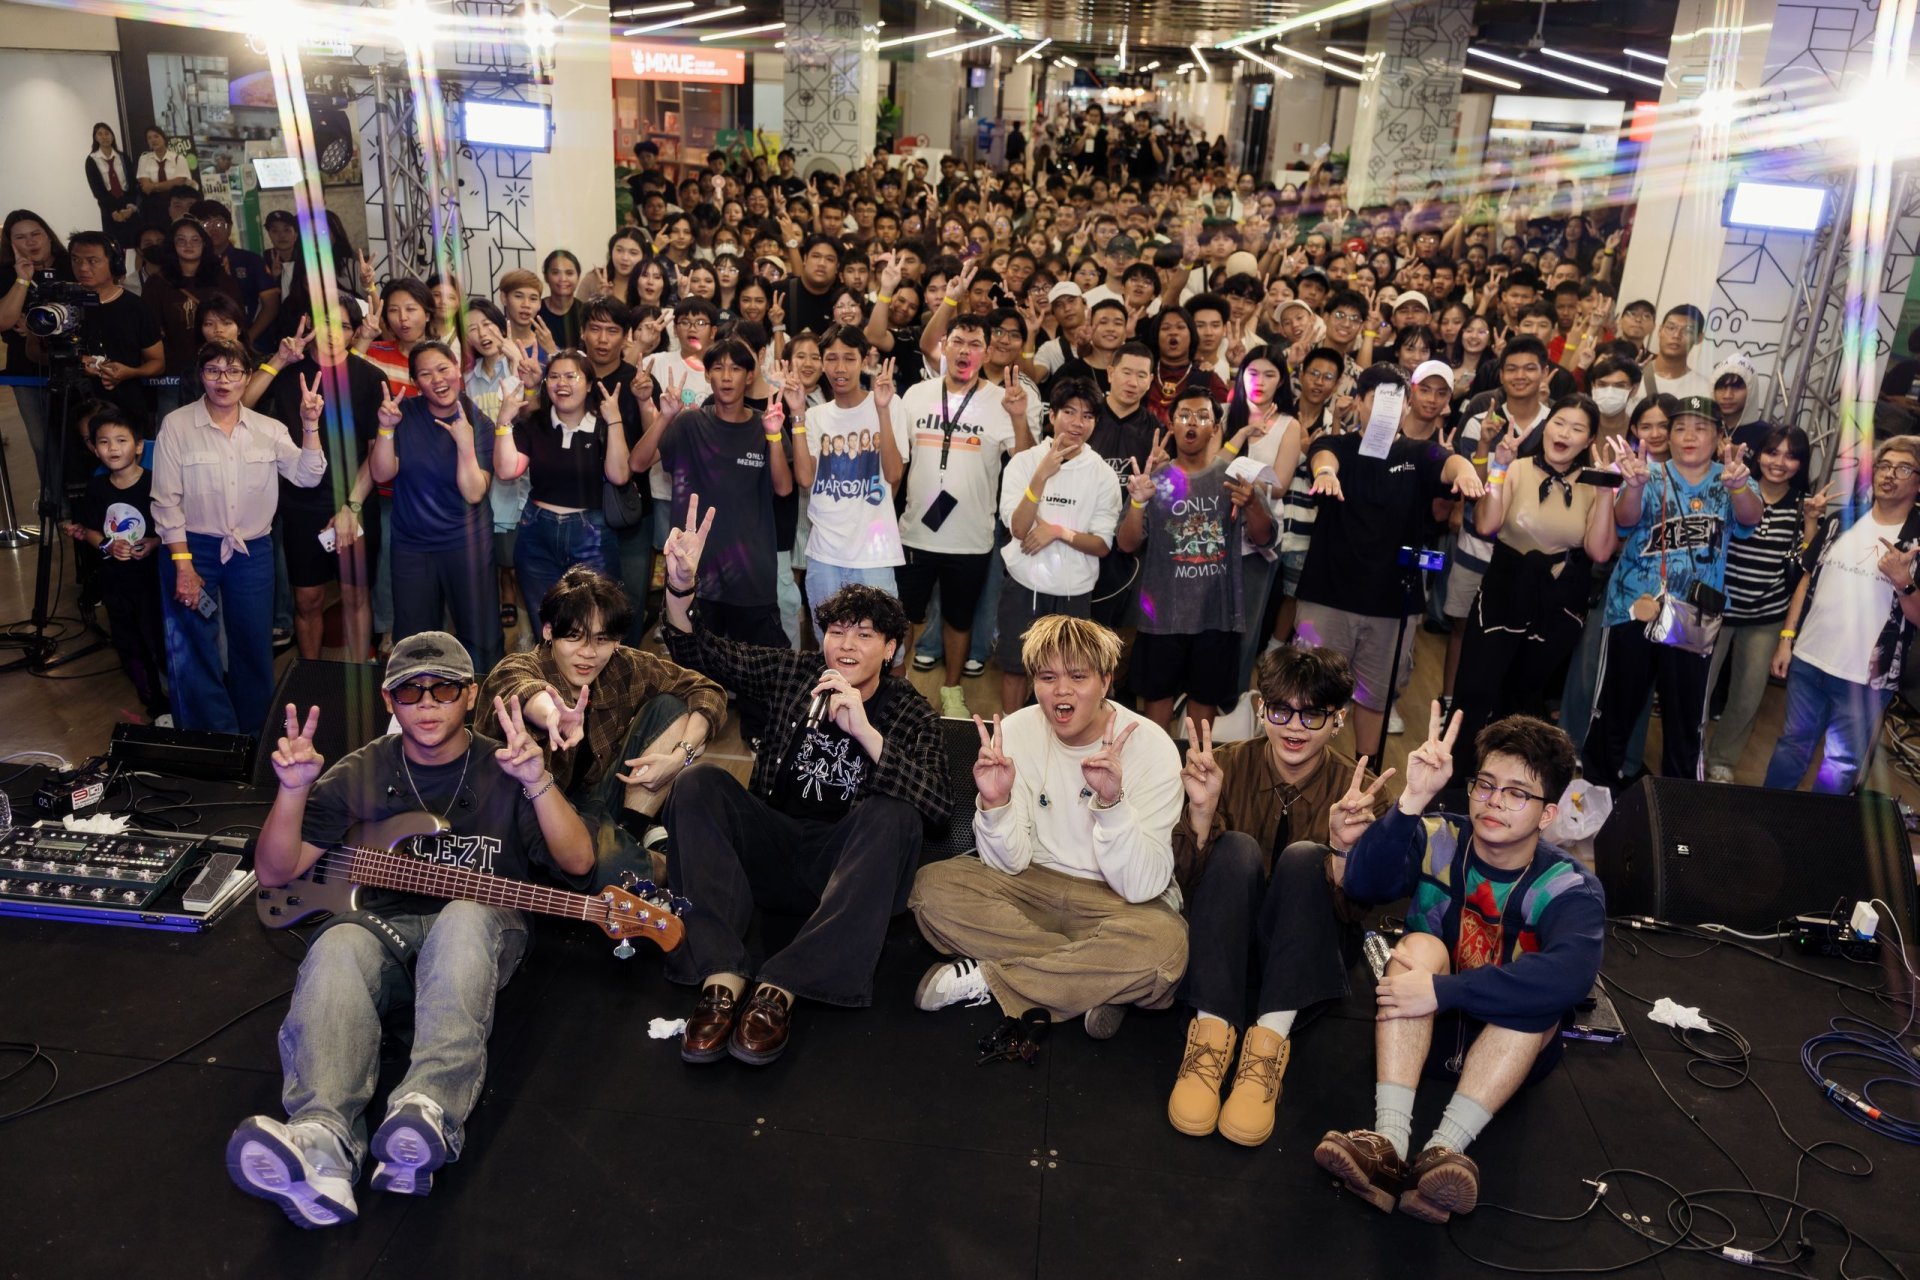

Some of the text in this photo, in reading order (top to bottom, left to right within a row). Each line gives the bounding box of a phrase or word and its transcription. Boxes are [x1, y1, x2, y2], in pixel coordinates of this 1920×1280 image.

[645, 51, 696, 74] MIXUE
[865, 474, 886, 505] 5
[1171, 495, 1219, 516] ONLY
[38, 797, 49, 808] 05
